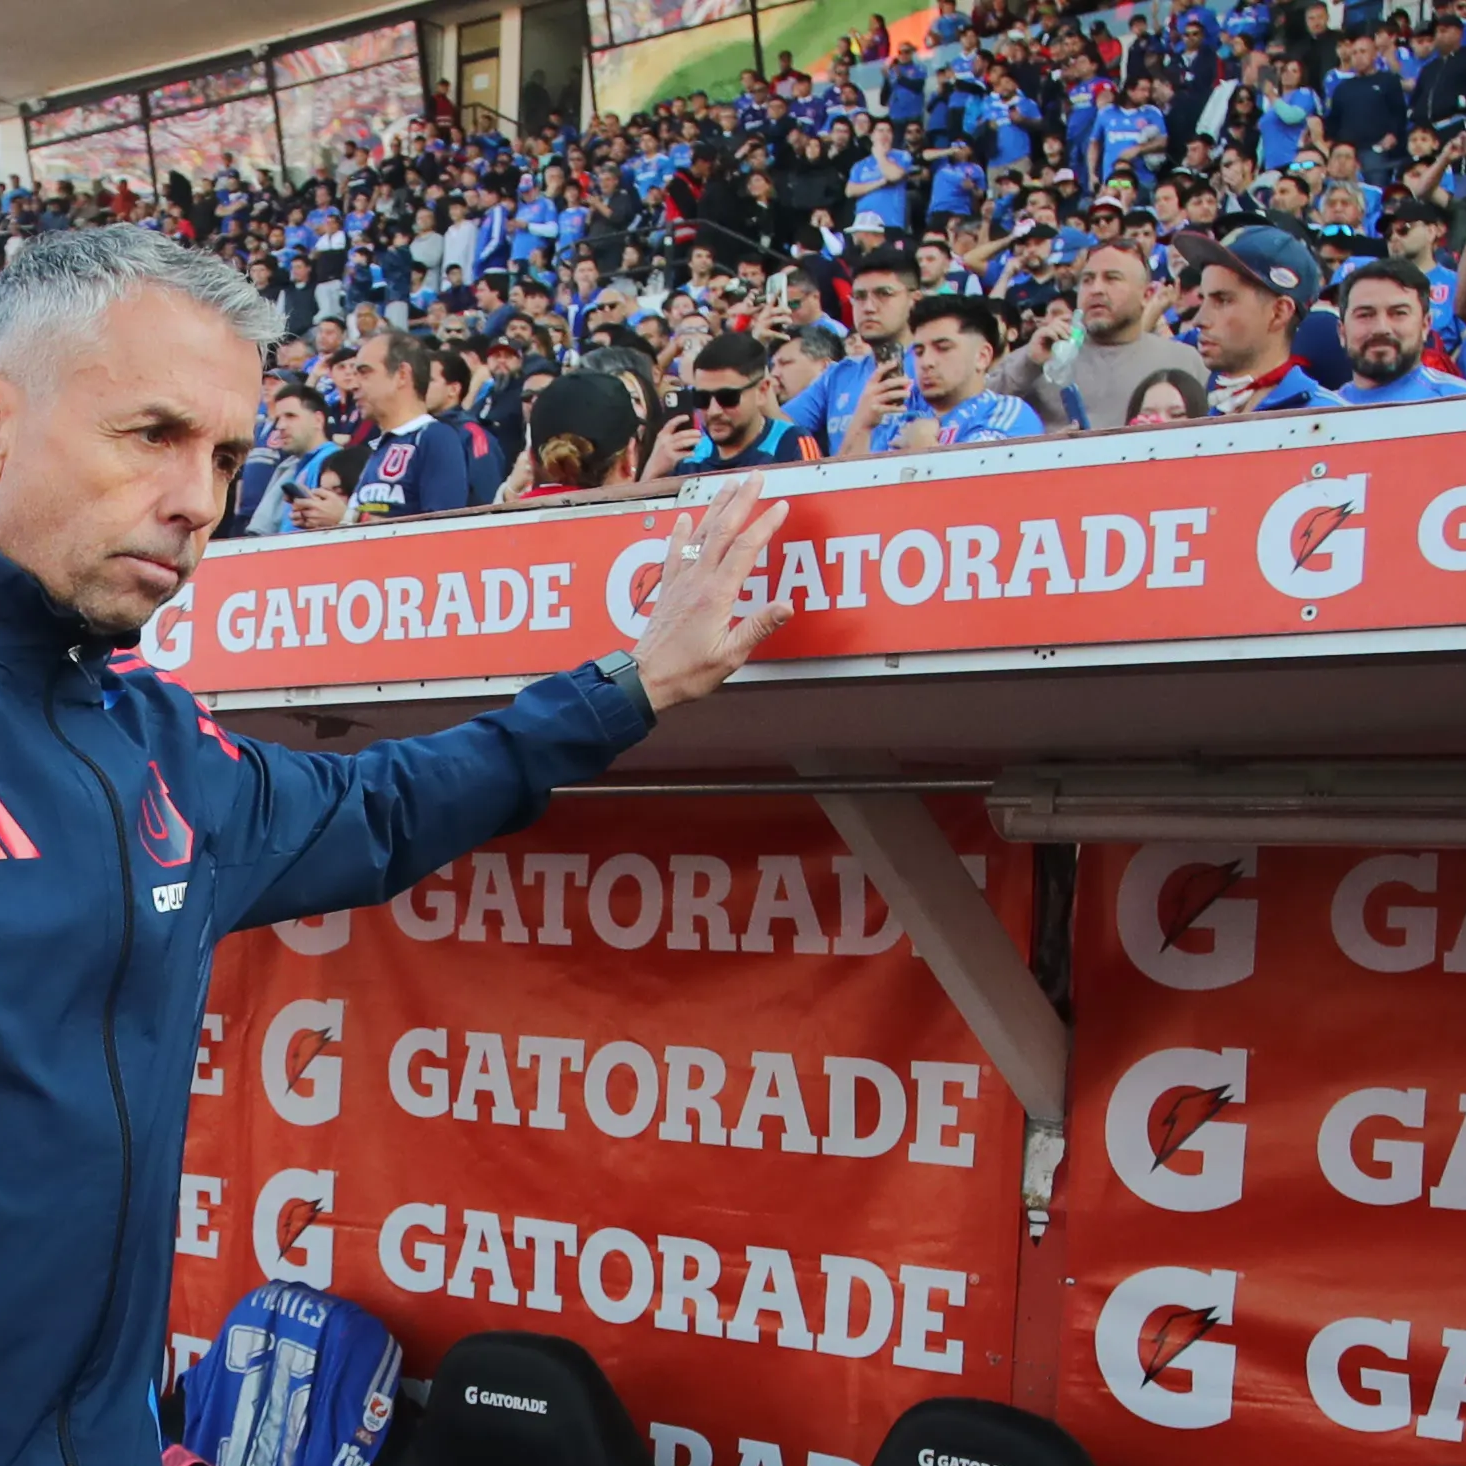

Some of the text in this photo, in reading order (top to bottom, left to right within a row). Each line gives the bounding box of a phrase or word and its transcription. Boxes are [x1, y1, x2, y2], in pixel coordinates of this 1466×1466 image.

[217, 563, 571, 653] GATORADE
[1257, 473, 1368, 599] G
[261, 999, 345, 1127] G
[388, 1027, 980, 1169] GATORADE
[1104, 1047, 1248, 1213] G
[252, 1170, 335, 1291] G
[378, 1203, 967, 1376] GATORADE
[1095, 1267, 1236, 1430] G
[465, 1386, 547, 1414] G GATORADE
